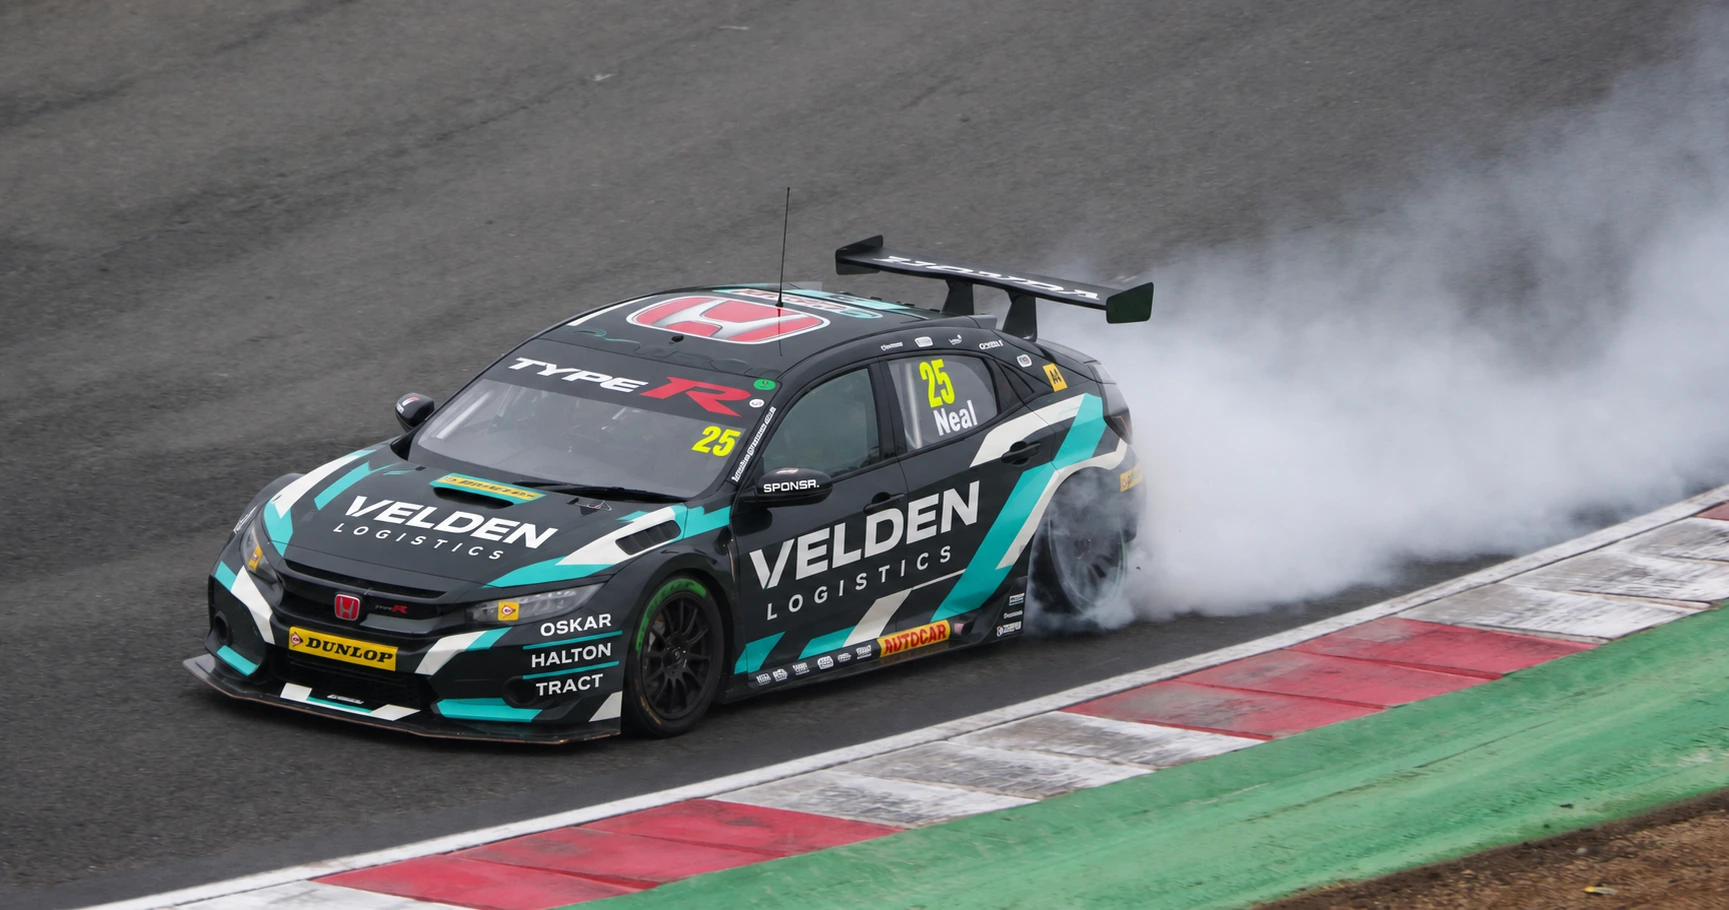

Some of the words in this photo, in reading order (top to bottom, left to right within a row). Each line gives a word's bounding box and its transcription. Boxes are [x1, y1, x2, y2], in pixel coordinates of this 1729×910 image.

[508, 357, 648, 393] TYPE
[641, 376, 751, 418] R
[919, 359, 956, 408] 25
[933, 400, 977, 437] Neal
[692, 426, 741, 457] 25
[763, 479, 820, 494] SPONSR.
[345, 495, 557, 549] VELDEN
[749, 480, 980, 589] VELDEN
[333, 522, 504, 560] LOGISTICS
[767, 545, 952, 620] LOGISTICS
[540, 613, 612, 637] OSKAR
[884, 629, 946, 655] AUTOCAR
[305, 637, 393, 663] DUNLOP
[531, 642, 612, 668] HALTON
[536, 673, 604, 697] TRACT
